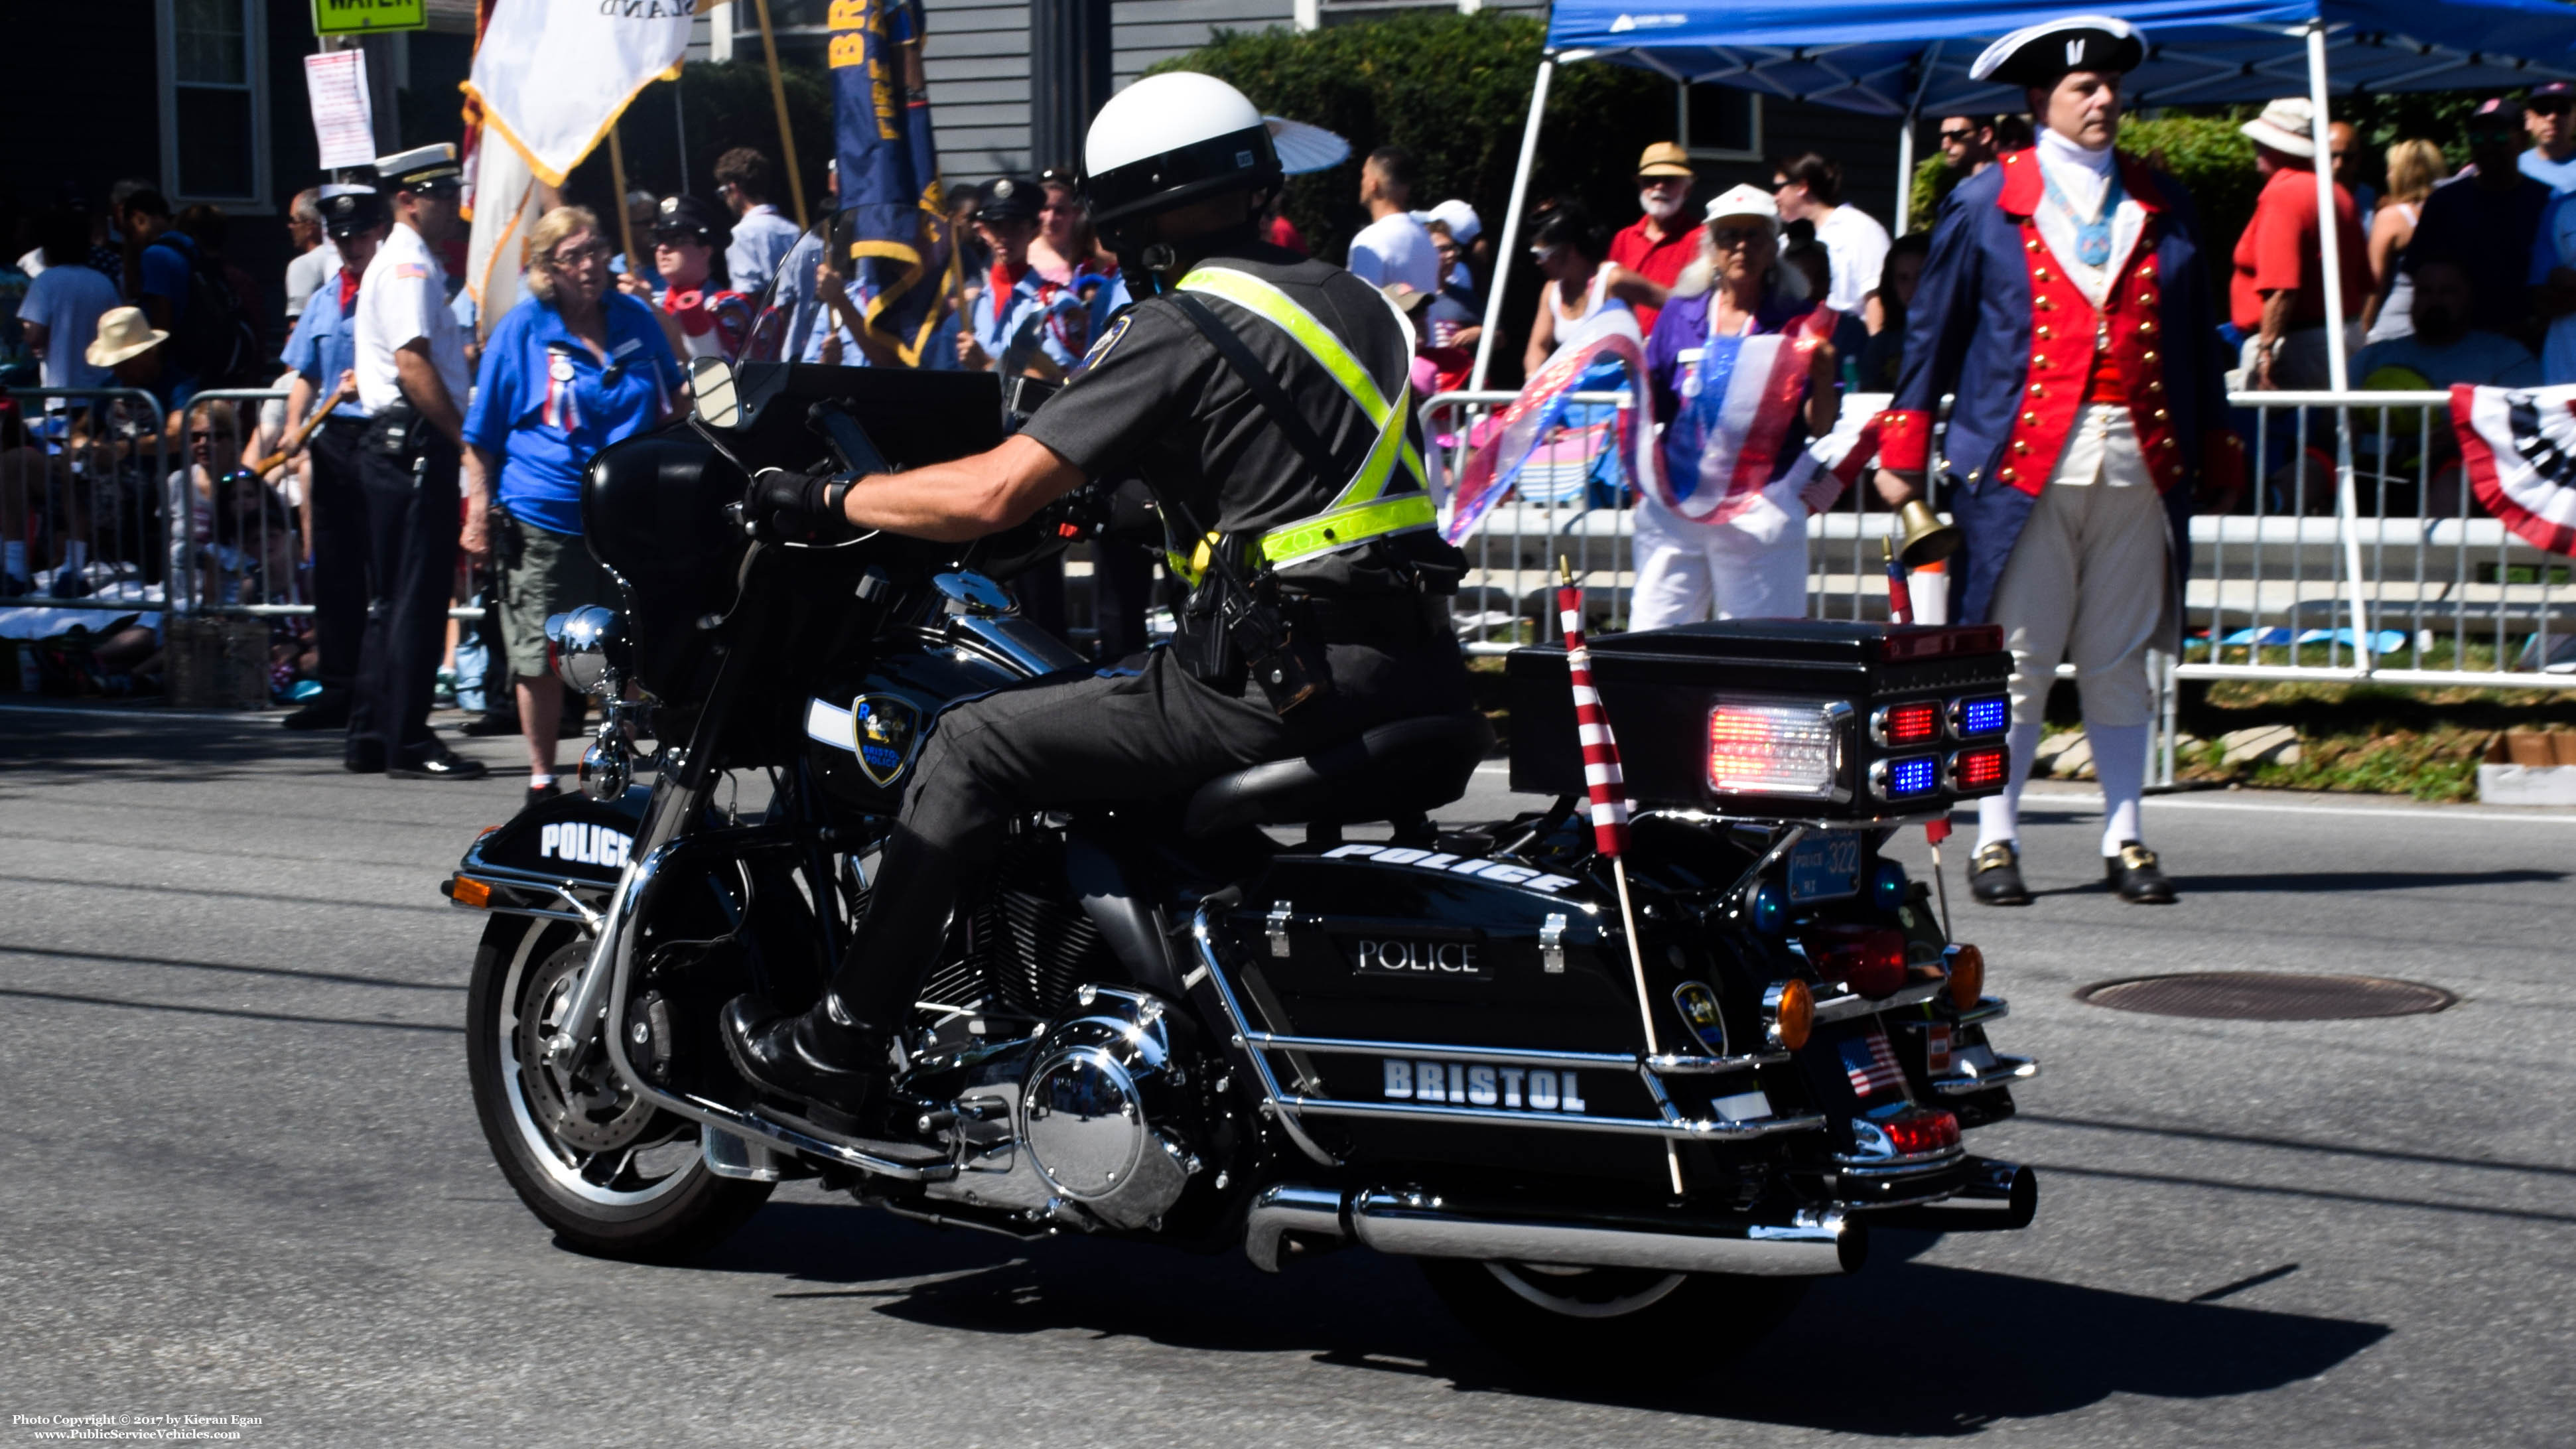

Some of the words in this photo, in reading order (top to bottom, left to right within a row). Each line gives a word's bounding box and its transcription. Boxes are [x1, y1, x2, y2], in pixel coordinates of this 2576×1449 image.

[865, 754, 899, 769] POLICE
[1322, 844, 1580, 892] POLICE
[1829, 840, 1858, 874] 322
[1359, 939, 1479, 973] POLICE
[1384, 1059, 1585, 1112] BRISTOL
